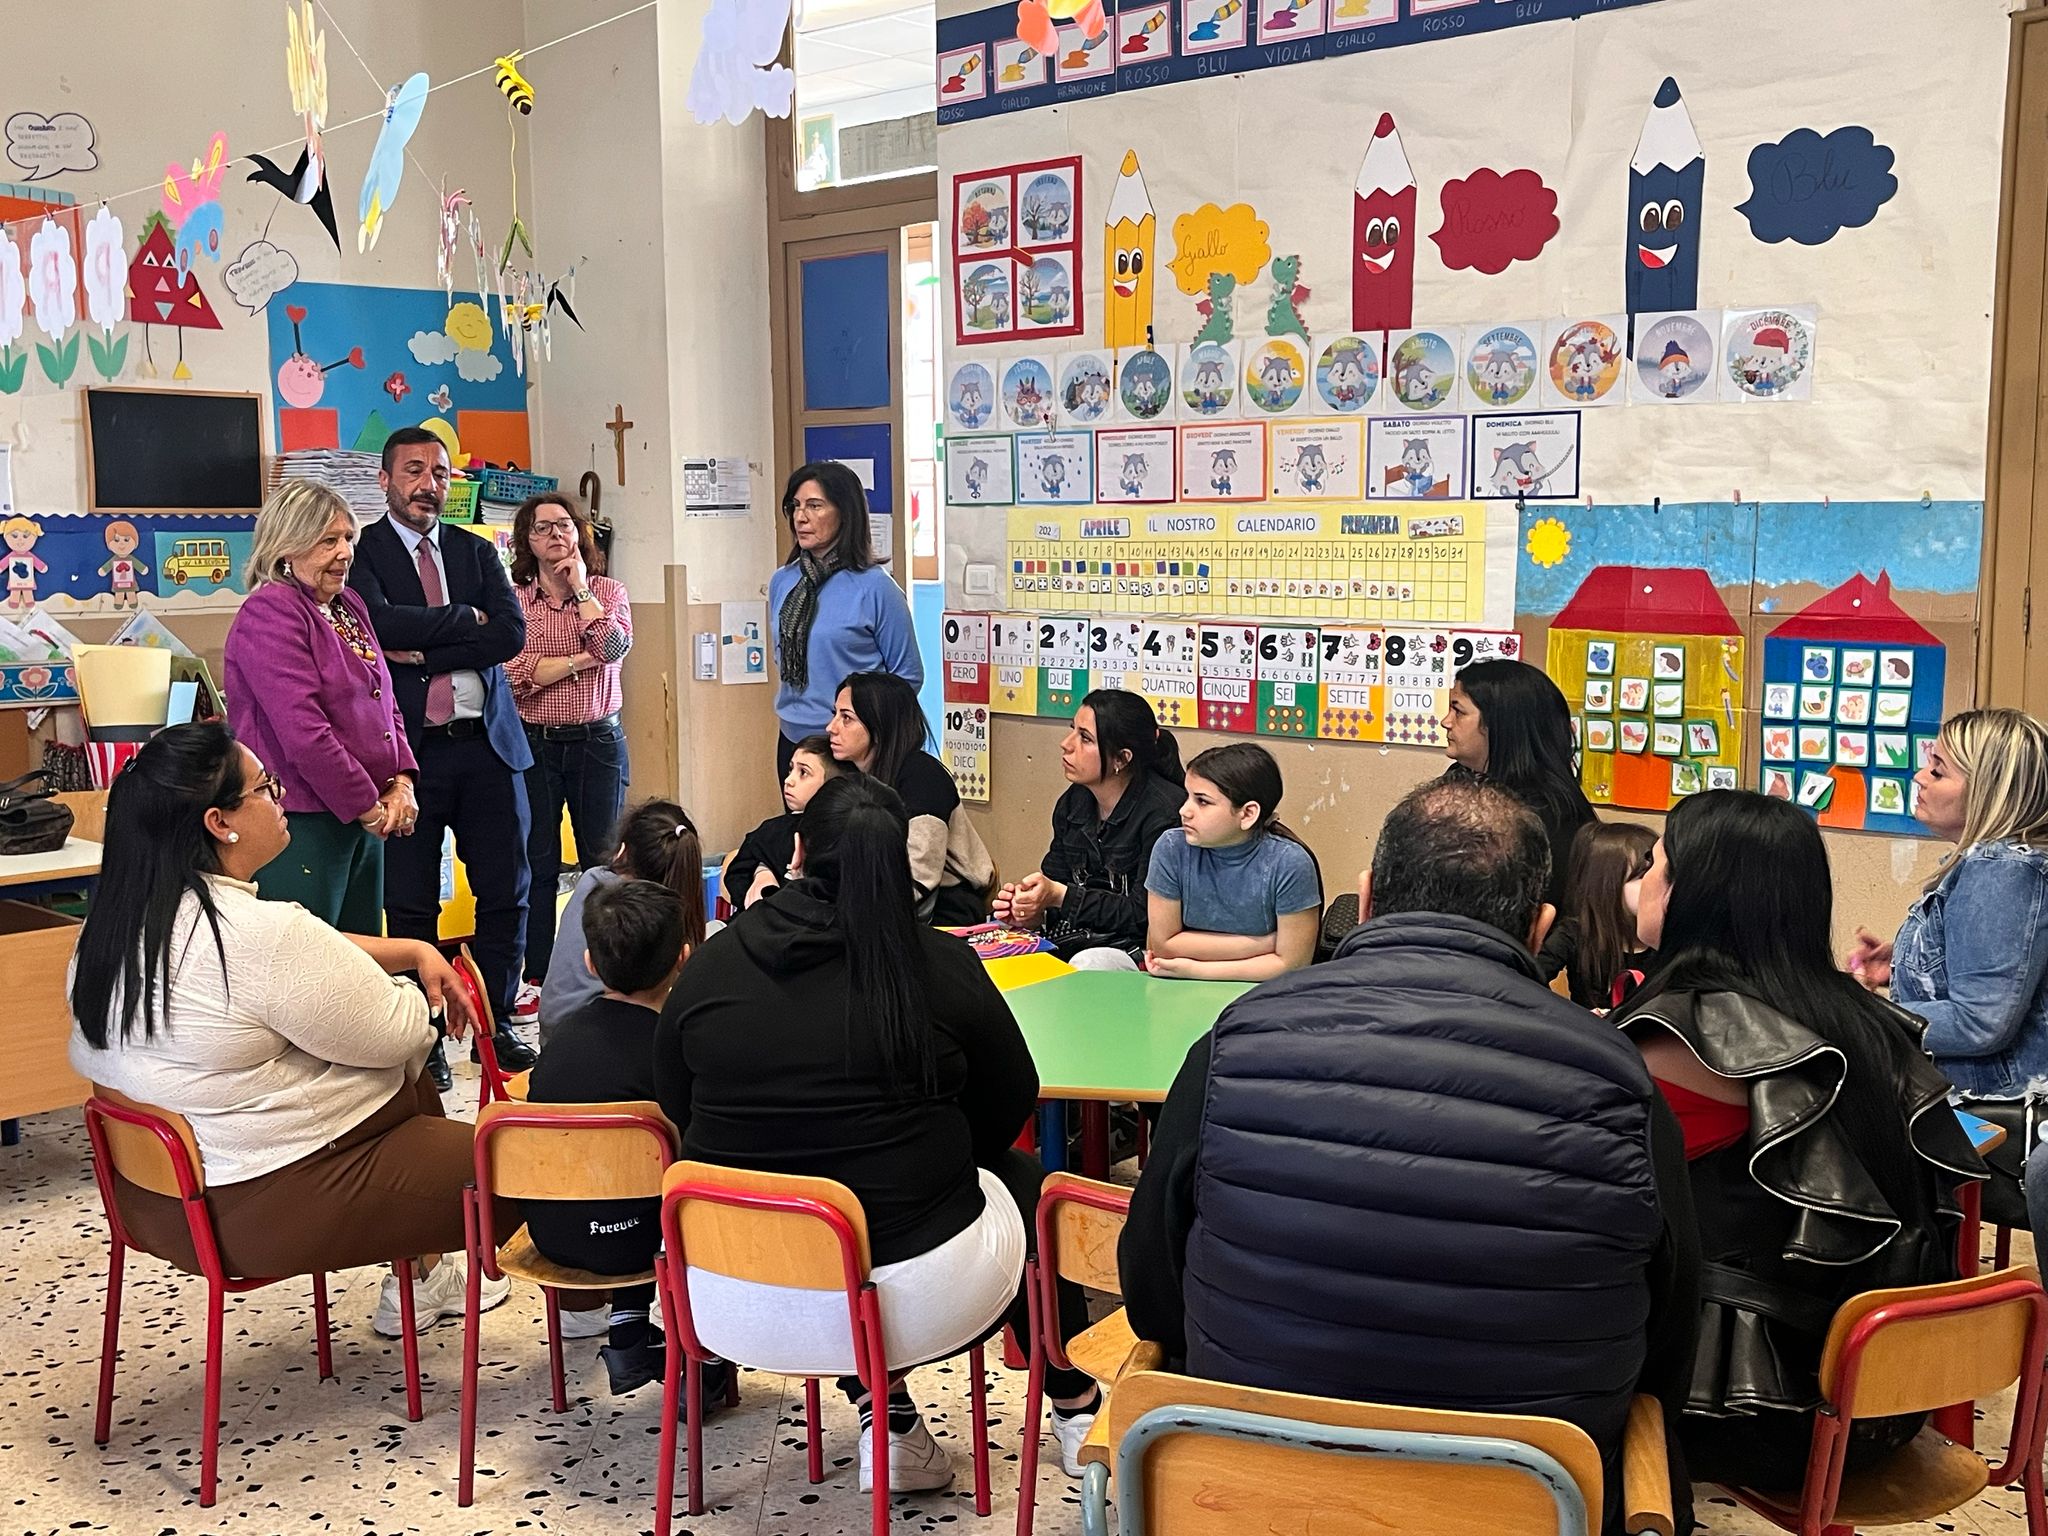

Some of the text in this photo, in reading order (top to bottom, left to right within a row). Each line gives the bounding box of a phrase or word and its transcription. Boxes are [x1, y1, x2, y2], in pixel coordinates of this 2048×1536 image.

[1515, 4, 1542, 18] BLU
[1423, 15, 1466, 33] ROSSO
[1336, 32, 1376, 49] GIALLO
[1265, 43, 1312, 64] VIOLA
[1198, 54, 1227, 75] BLU
[1125, 65, 1170, 86] ROSSO
[1057, 81, 1108, 98] ARANCIONE
[1001, 96, 1031, 110] GIALLO
[939, 107, 965, 122] ROSSO
[1771, 148, 1856, 205] Blu
[1178, 229, 1229, 277] Giallo
[1656, 322, 1697, 336] NOVEMBRE
[1751, 315, 1792, 331] DICEMBRE
[1483, 328, 1523, 346] SETTEMBRE
[1383, 420, 1411, 428] SABATO
[1486, 420, 1522, 428] DOMENICA
[1084, 520, 1120, 536] APRILE
[1149, 517, 1316, 532] IL NOSTRO CALENDARIO
[1341, 515, 1399, 534] PRIMAVERA
[1016, 547, 1462, 558] 1 2 3 4 5 6 7 8 9 10 11 12 13 14 15 16 17 18 19 20 21 22 23 24 25 26 27 28 29 30 31
[945, 620, 959, 644] 0
[992, 624, 1001, 646] 1
[1040, 624, 1055, 648] 2
[1091, 627, 1107, 652] 3
[1143, 630, 1161, 656] 4
[1200, 632, 1218, 658] 5
[1260, 634, 1278, 660] 6
[1322, 636, 1342, 662] 7
[1386, 636, 1406, 666] 8
[972, 653, 976, 661] 0
[1453, 638, 1473, 666] 9
[1041, 658, 1046, 666] 2
[1069, 659, 1074, 667] 2
[1093, 660, 1138, 670] 3 3 3 3 3
[1155, 663, 1161, 671] 4
[1176, 664, 1182, 672] 4
[952, 666, 976, 679] ZERO
[1000, 671, 1022, 683] UNO
[1050, 673, 1070, 686] DUE
[1203, 667, 1252, 677] 5 5 5 5 5
[1261, 670, 1312, 681] 6 6 6 6 6
[1335, 673, 1341, 681] 7
[1347, 674, 1352, 682] 7
[1359, 674, 1365, 682] 7
[1372, 675, 1378, 683] 7
[1104, 676, 1122, 689] TRE
[1142, 678, 1195, 694] QUATTRO
[1387, 676, 1444, 687] 8 8 8 8 8
[1204, 682, 1247, 698] CINQUE
[1276, 687, 1293, 701] SEI
[1330, 689, 1367, 705] SETTE
[1394, 693, 1432, 708] OTTO
[946, 711, 963, 731] 10
[954, 756, 976, 768] DIECI
[590, 1217, 640, 1235] Forever
